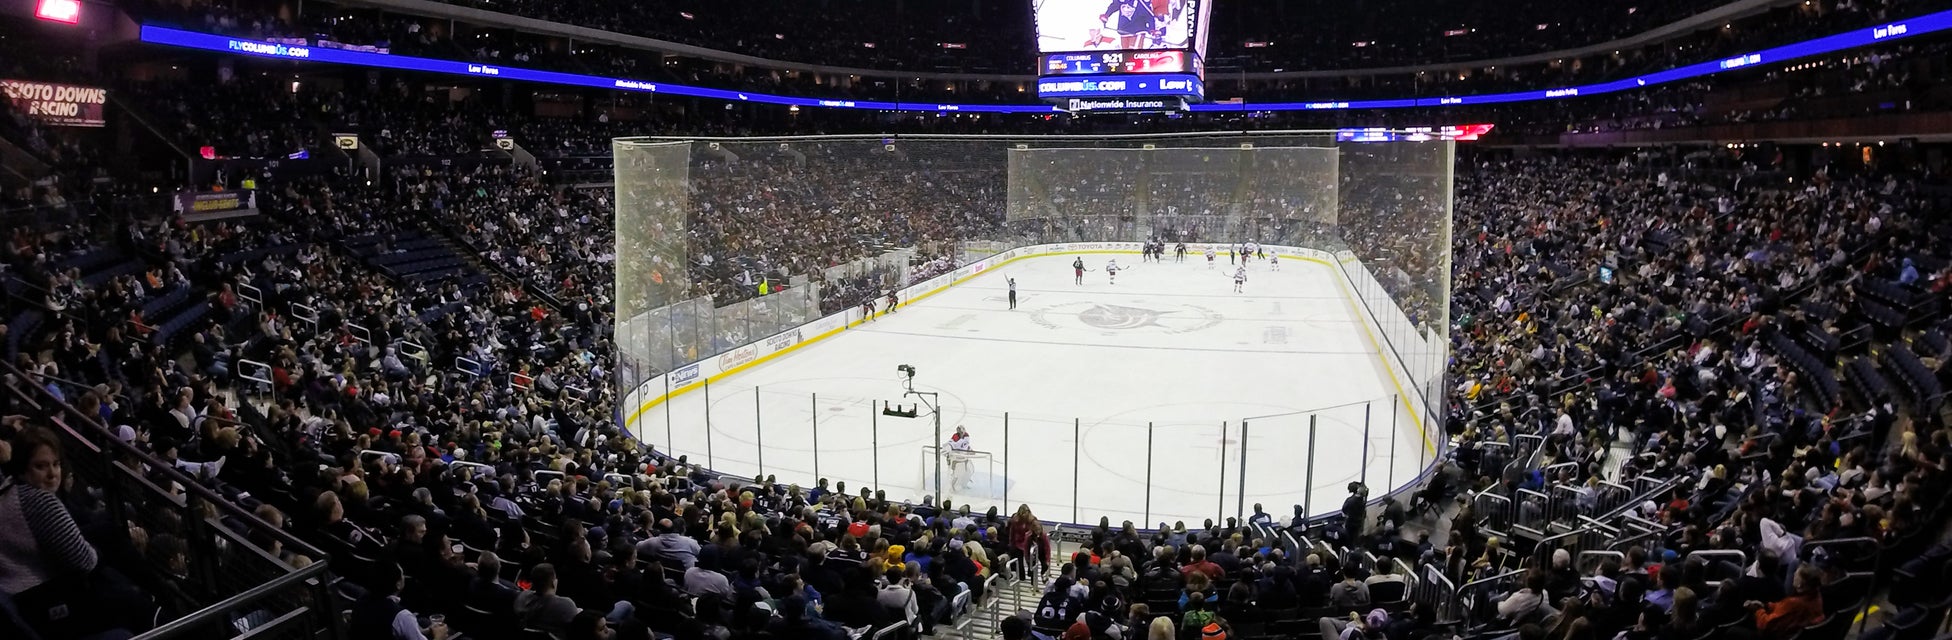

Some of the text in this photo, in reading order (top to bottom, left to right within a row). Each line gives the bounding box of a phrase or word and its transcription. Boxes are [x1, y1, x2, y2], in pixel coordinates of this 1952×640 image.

[1874, 28, 1887, 39] Low
[1102, 53, 1123, 63] 9:21
[1075, 61, 1082, 71] 1
[55, 86, 107, 105] DOWNS
[29, 101, 79, 117] RACINO
[1081, 100, 1163, 109] Nationwide Insurance
